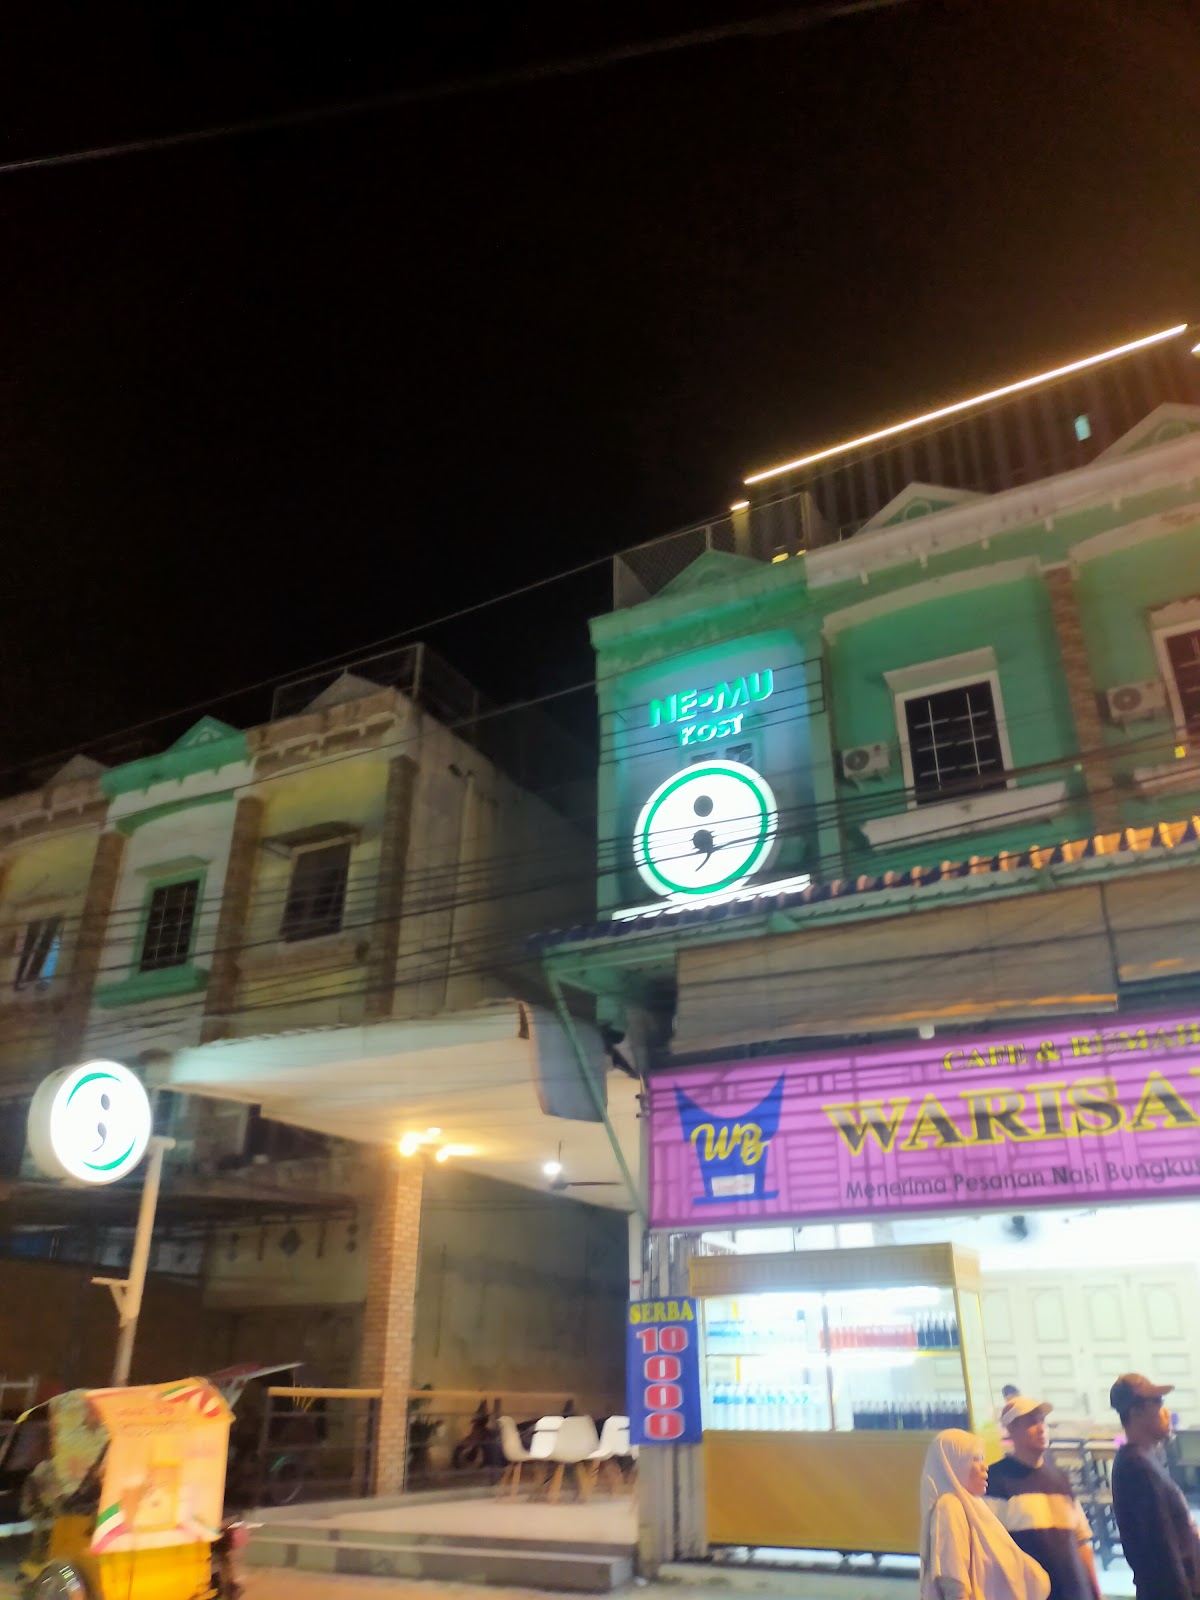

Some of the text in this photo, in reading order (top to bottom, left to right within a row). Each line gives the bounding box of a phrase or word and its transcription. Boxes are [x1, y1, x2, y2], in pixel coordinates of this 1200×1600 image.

[943, 1043, 1027, 1071] CAFE
[1036, 1040, 1060, 1063] &
[822, 1067, 1200, 1156] WARISA
[846, 1177, 947, 1200] Menerima
[953, 1169, 1045, 1192] Pesanan
[1051, 1162, 1100, 1185] Nasi
[629, 1300, 694, 1324] SERBA
